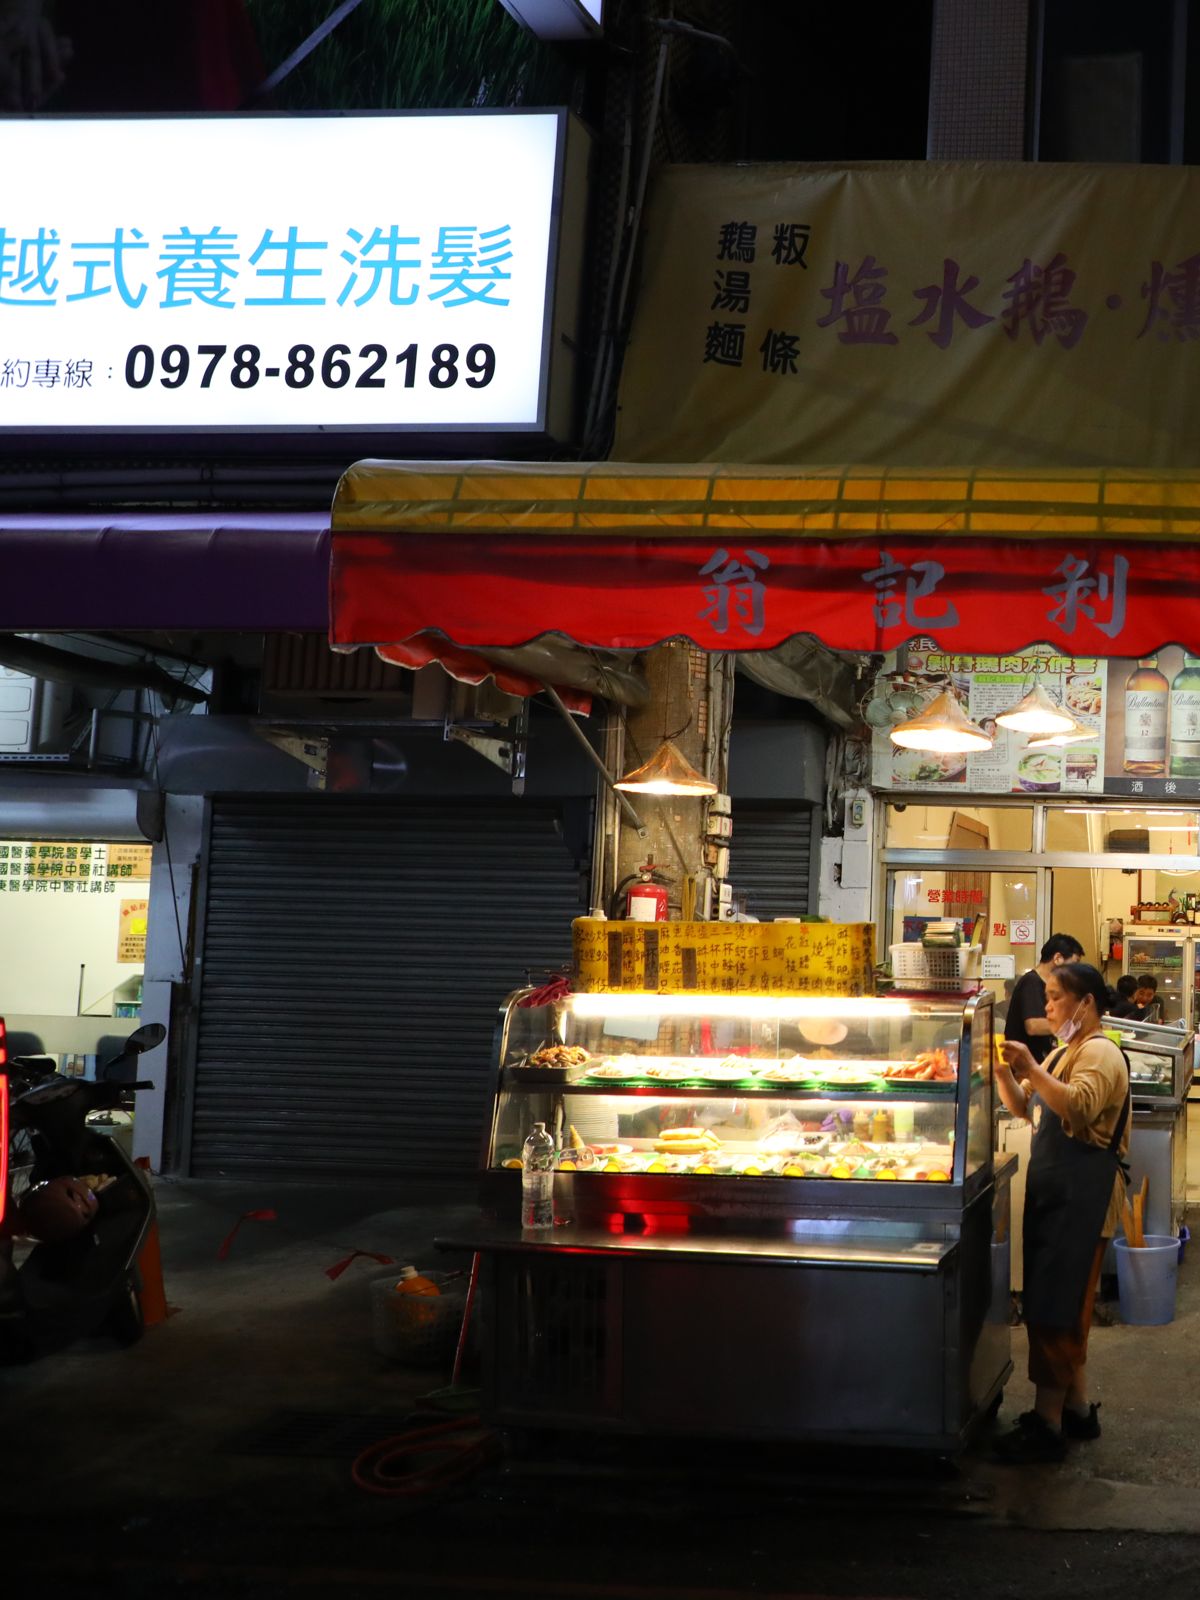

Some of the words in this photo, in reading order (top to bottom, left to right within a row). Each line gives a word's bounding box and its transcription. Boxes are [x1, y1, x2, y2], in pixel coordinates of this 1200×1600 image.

[0, 224, 514, 309] 越式養生洗髮
[124, 343, 497, 389] 0978-862189
